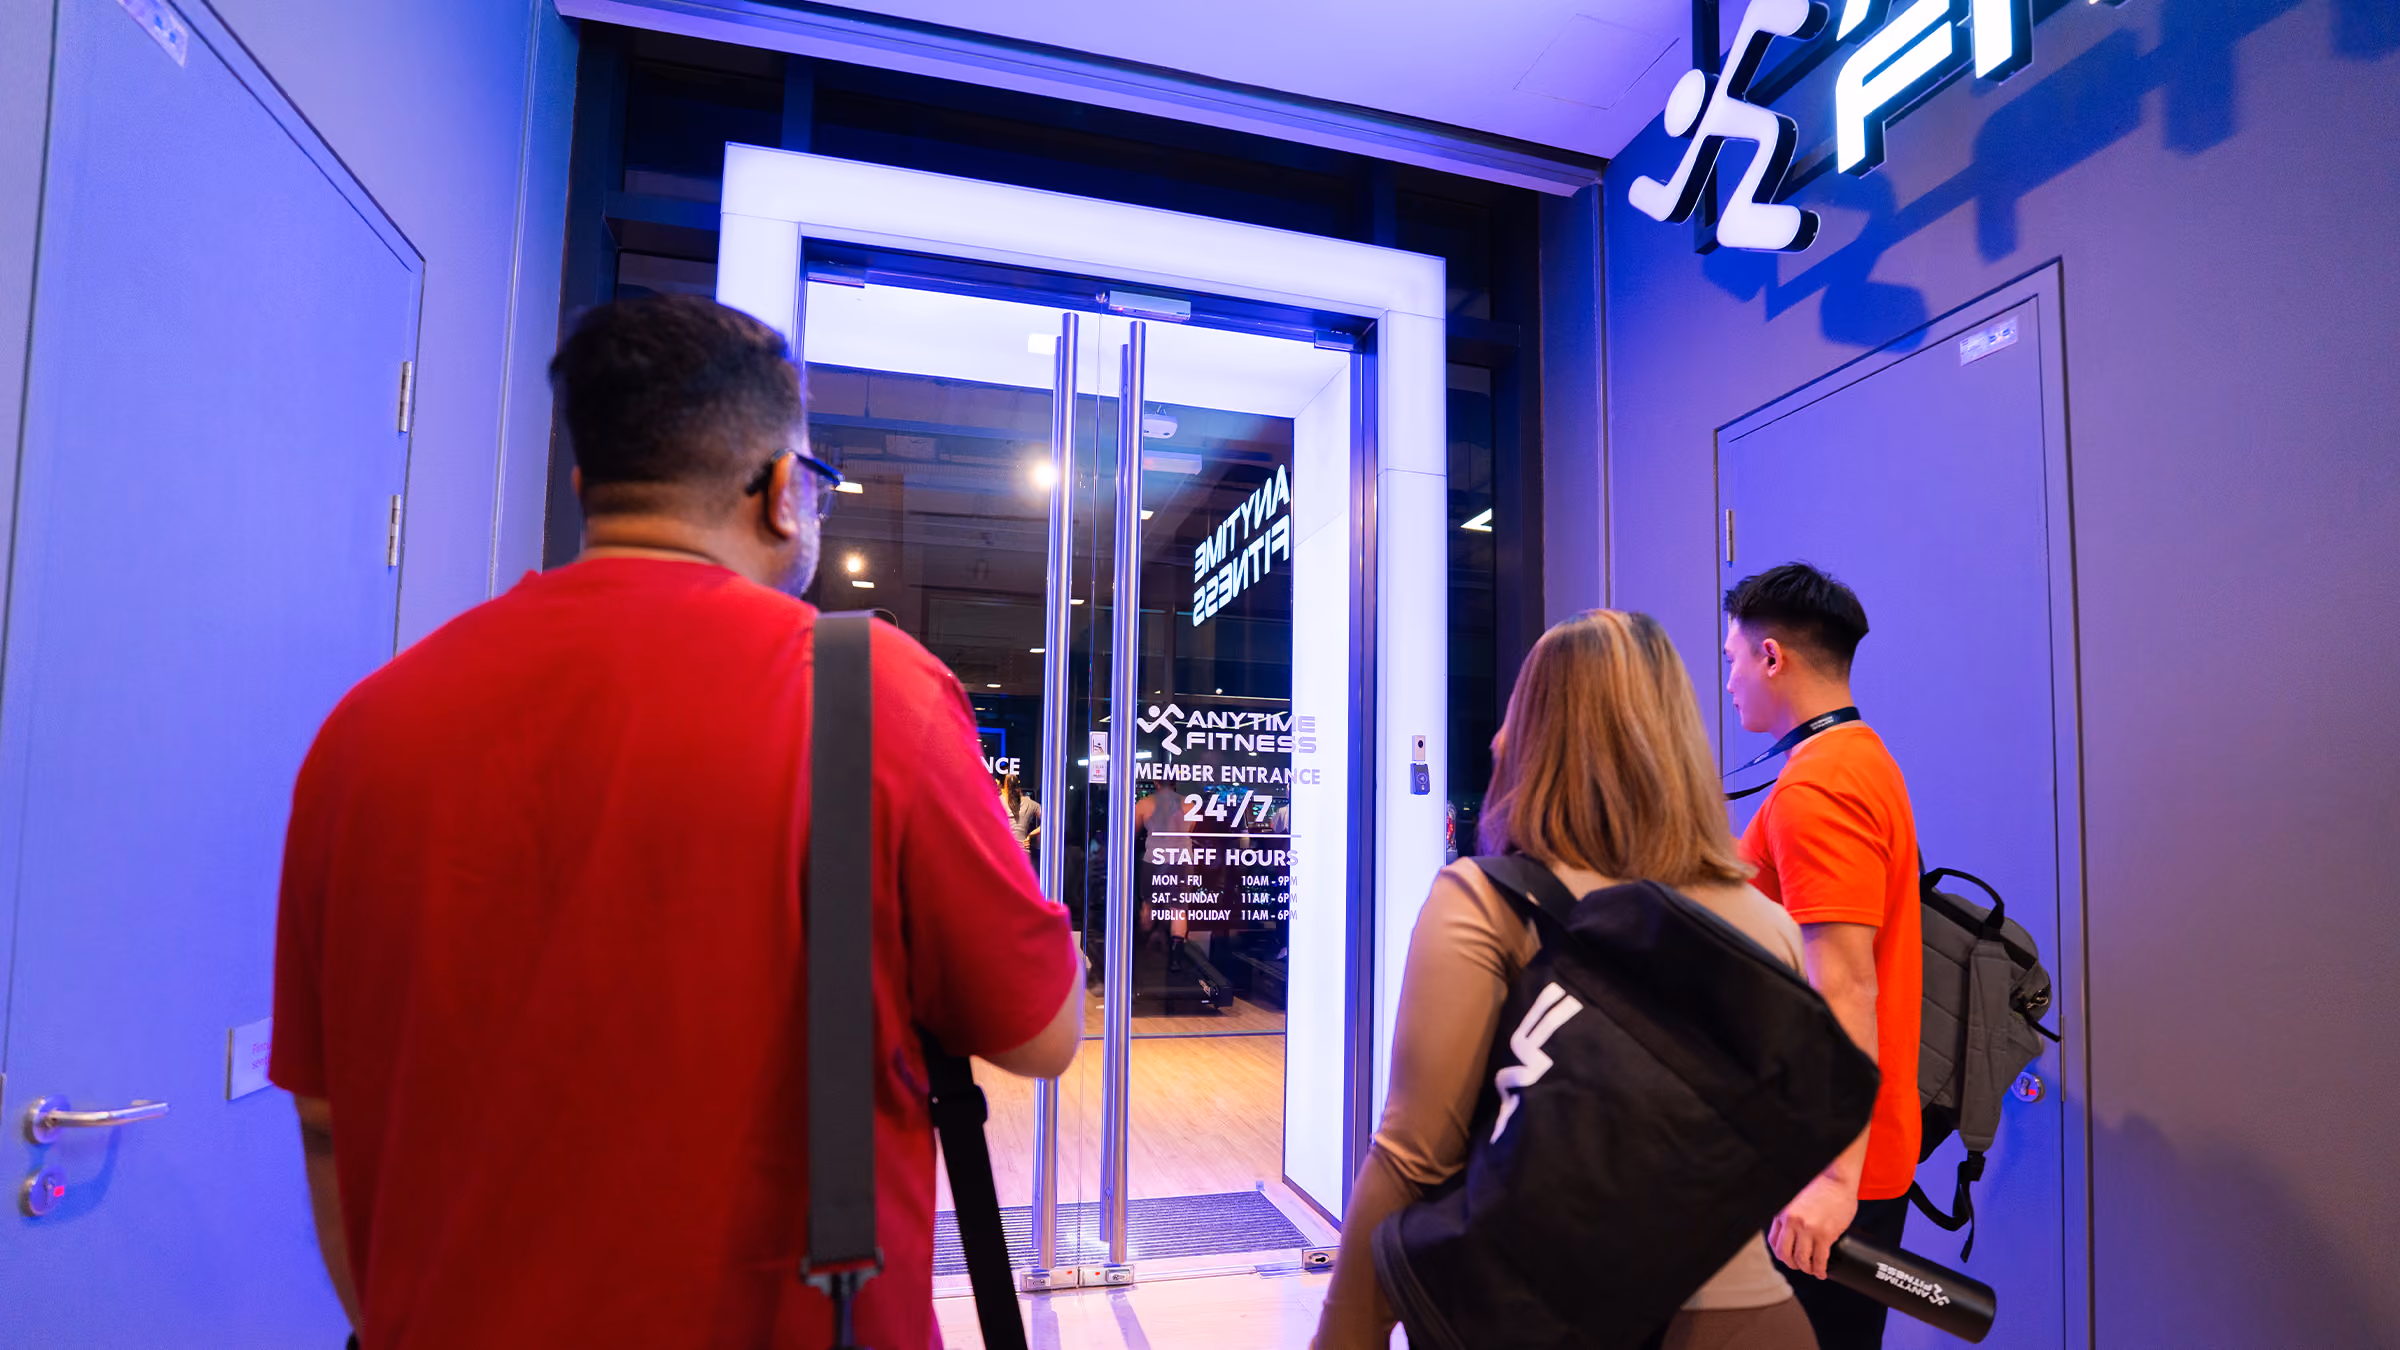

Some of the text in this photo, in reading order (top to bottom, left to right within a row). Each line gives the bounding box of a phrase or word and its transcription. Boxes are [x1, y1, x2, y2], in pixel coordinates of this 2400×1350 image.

[1186, 710, 1316, 733] ANYTIME
[1186, 732, 1317, 754] FITNESS
[1135, 762, 1321, 785] MEMBER ENTRANCE
[1151, 848, 1299, 867] STAFF HOURS
[1151, 875, 1178, 886] MON
[1187, 875, 1203, 886] FRI
[1241, 875, 1269, 886] 10AM
[1278, 875, 1298, 886] 9PM
[1151, 892, 1171, 904] SAT
[1179, 892, 1220, 904] SUNDAY
[1241, 892, 1269, 904] 11AM
[1277, 892, 1298, 904] 6PM
[1151, 910, 1186, 921] PUBLIC
[1188, 910, 1231, 921] HOLIDAY
[1241, 910, 1269, 921] 11AM
[1277, 910, 1298, 921] 6PM
